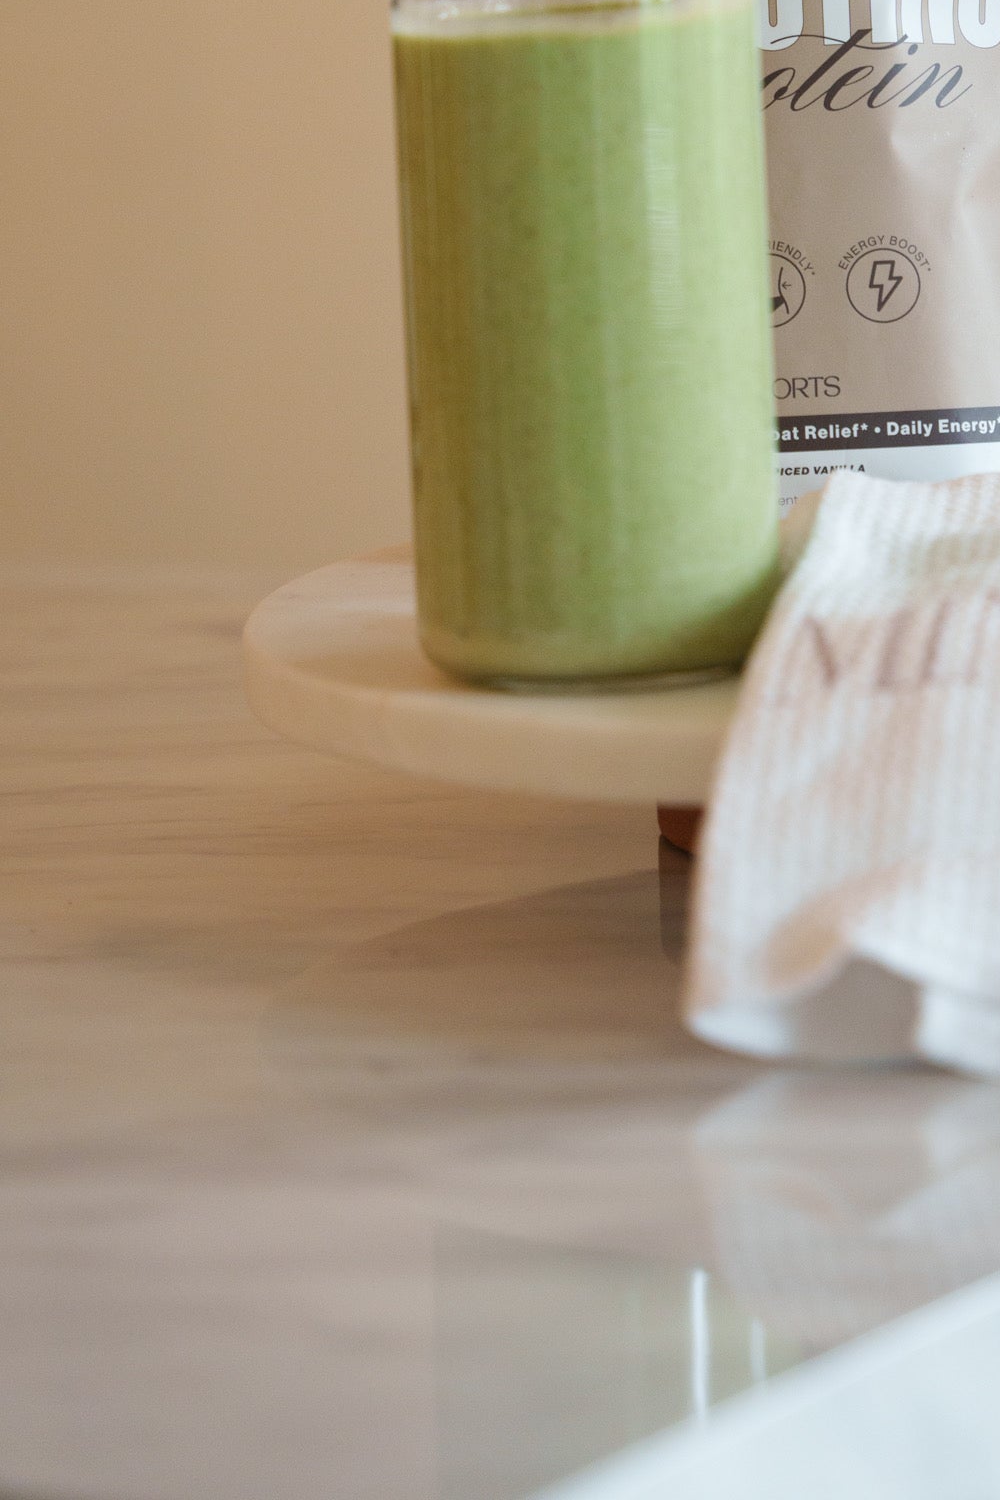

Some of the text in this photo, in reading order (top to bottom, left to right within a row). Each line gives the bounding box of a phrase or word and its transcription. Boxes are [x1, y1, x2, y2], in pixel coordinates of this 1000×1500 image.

[762, 28, 973, 111] otein
[838, 235, 885, 270] ENERGY
[773, 375, 841, 400] ORTS
[772, 426, 799, 441] oat
[886, 419, 933, 437] Daily
[779, 466, 810, 476] ICED
